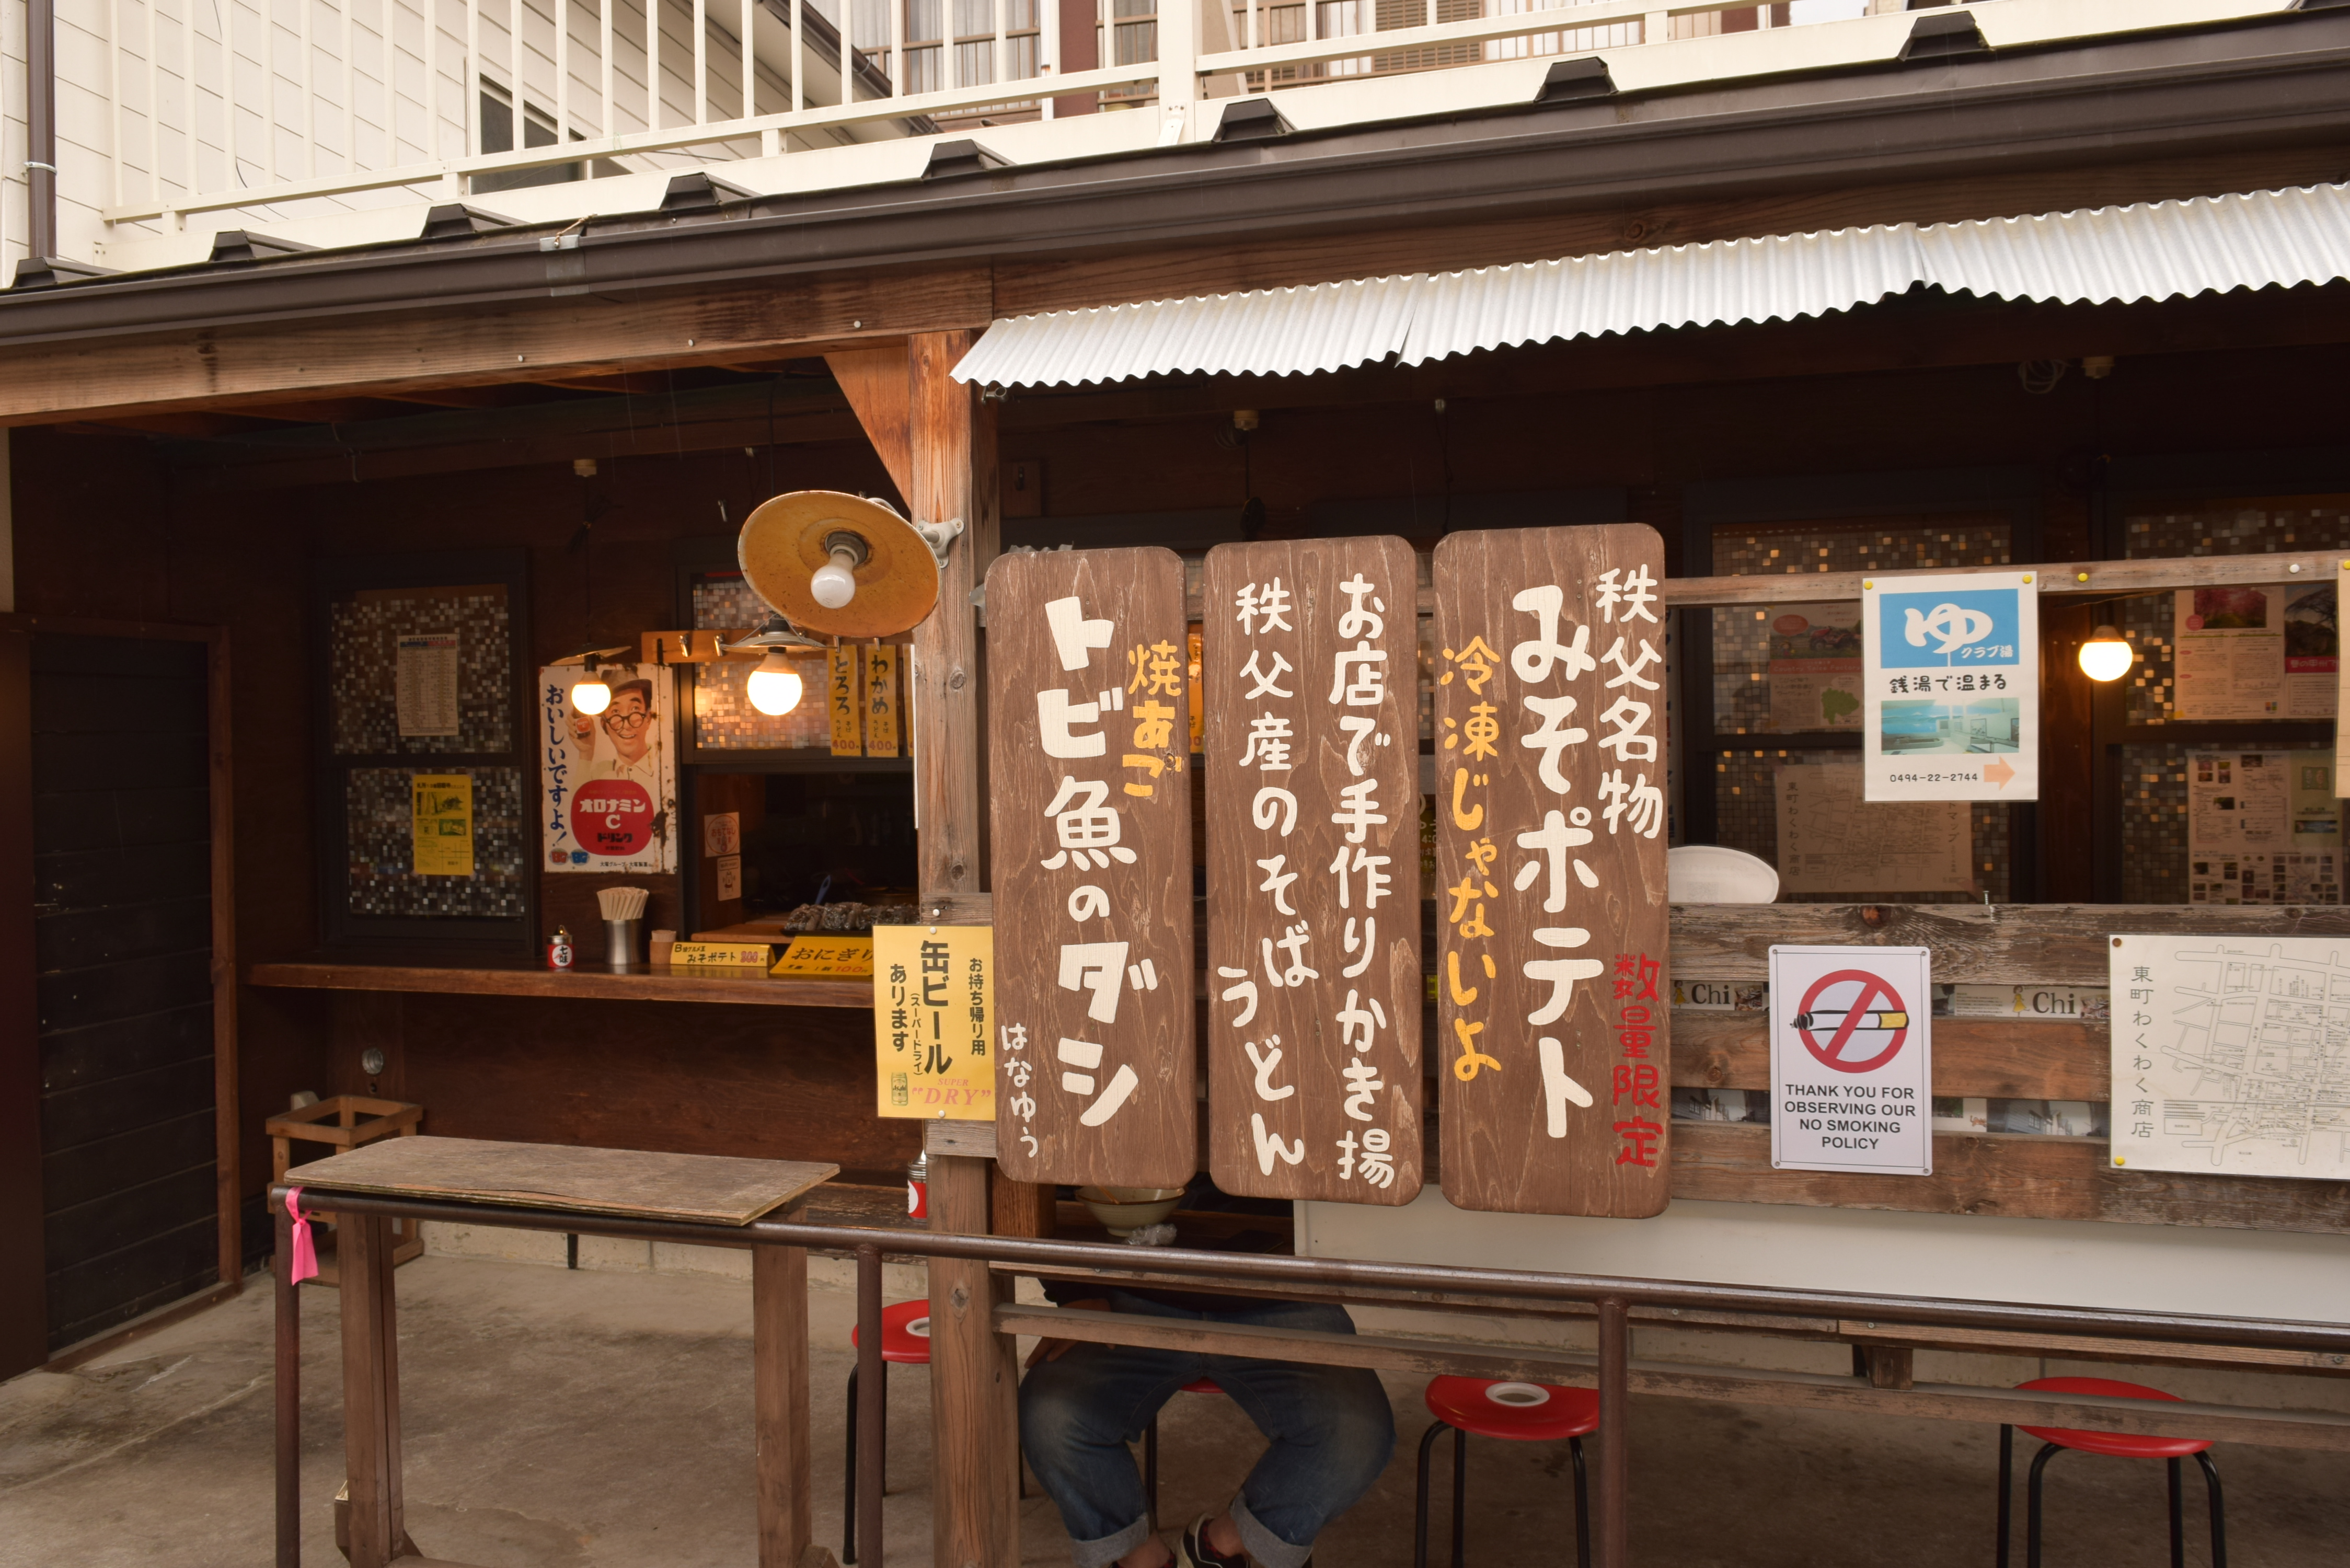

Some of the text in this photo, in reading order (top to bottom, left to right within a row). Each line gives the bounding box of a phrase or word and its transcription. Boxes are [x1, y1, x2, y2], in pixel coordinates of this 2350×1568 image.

[1904, 603, 1993, 654] ゆ
[1961, 644, 2014, 658] クラブ湯
[835, 655, 850, 715] とろろ
[871, 655, 889, 714] わかめ
[1890, 673, 2007, 694] 銭湯で温まる
[1596, 563, 1663, 839] 秩父名物
[1123, 639, 1182, 798] 焼あご
[546, 684, 568, 847] おいしいですよ！
[1890, 773, 1978, 782] 0494-22-2744
[580, 799, 646, 813] オロナミン
[606, 815, 621, 829] C
[597, 833, 633, 843] ドリンク
[1037, 596, 1157, 1126] トビ魚のダシ
[1441, 635, 1502, 1082] 冷凍じゃないよ
[1511, 584, 1604, 1138] みそポテト
[1329, 573, 1395, 1190] お店で手作りかき揚
[559, 946, 568, 963] 七味
[687, 951, 736, 963] みそポテト
[791, 947, 873, 962] おにぎり
[1691, 984, 1731, 1005] Chi
[2032, 992, 2076, 1014] Chi
[890, 964, 909, 1052] あります
[920, 940, 953, 1075] 缶ビール
[969, 958, 986, 1056] お持ち帰り用
[1612, 952, 1662, 1168] 数量限定
[2130, 966, 2154, 1138] 東町わくわく商店
[938, 1078, 969, 1086] SUPER
[1785, 1083, 1915, 1099] THANK YOU FOR
[1784, 1101, 1916, 1117] OBSERVING OUR
[1800, 1119, 1900, 1133] NO SMOKING
[1822, 1136, 1879, 1149] POLICY
